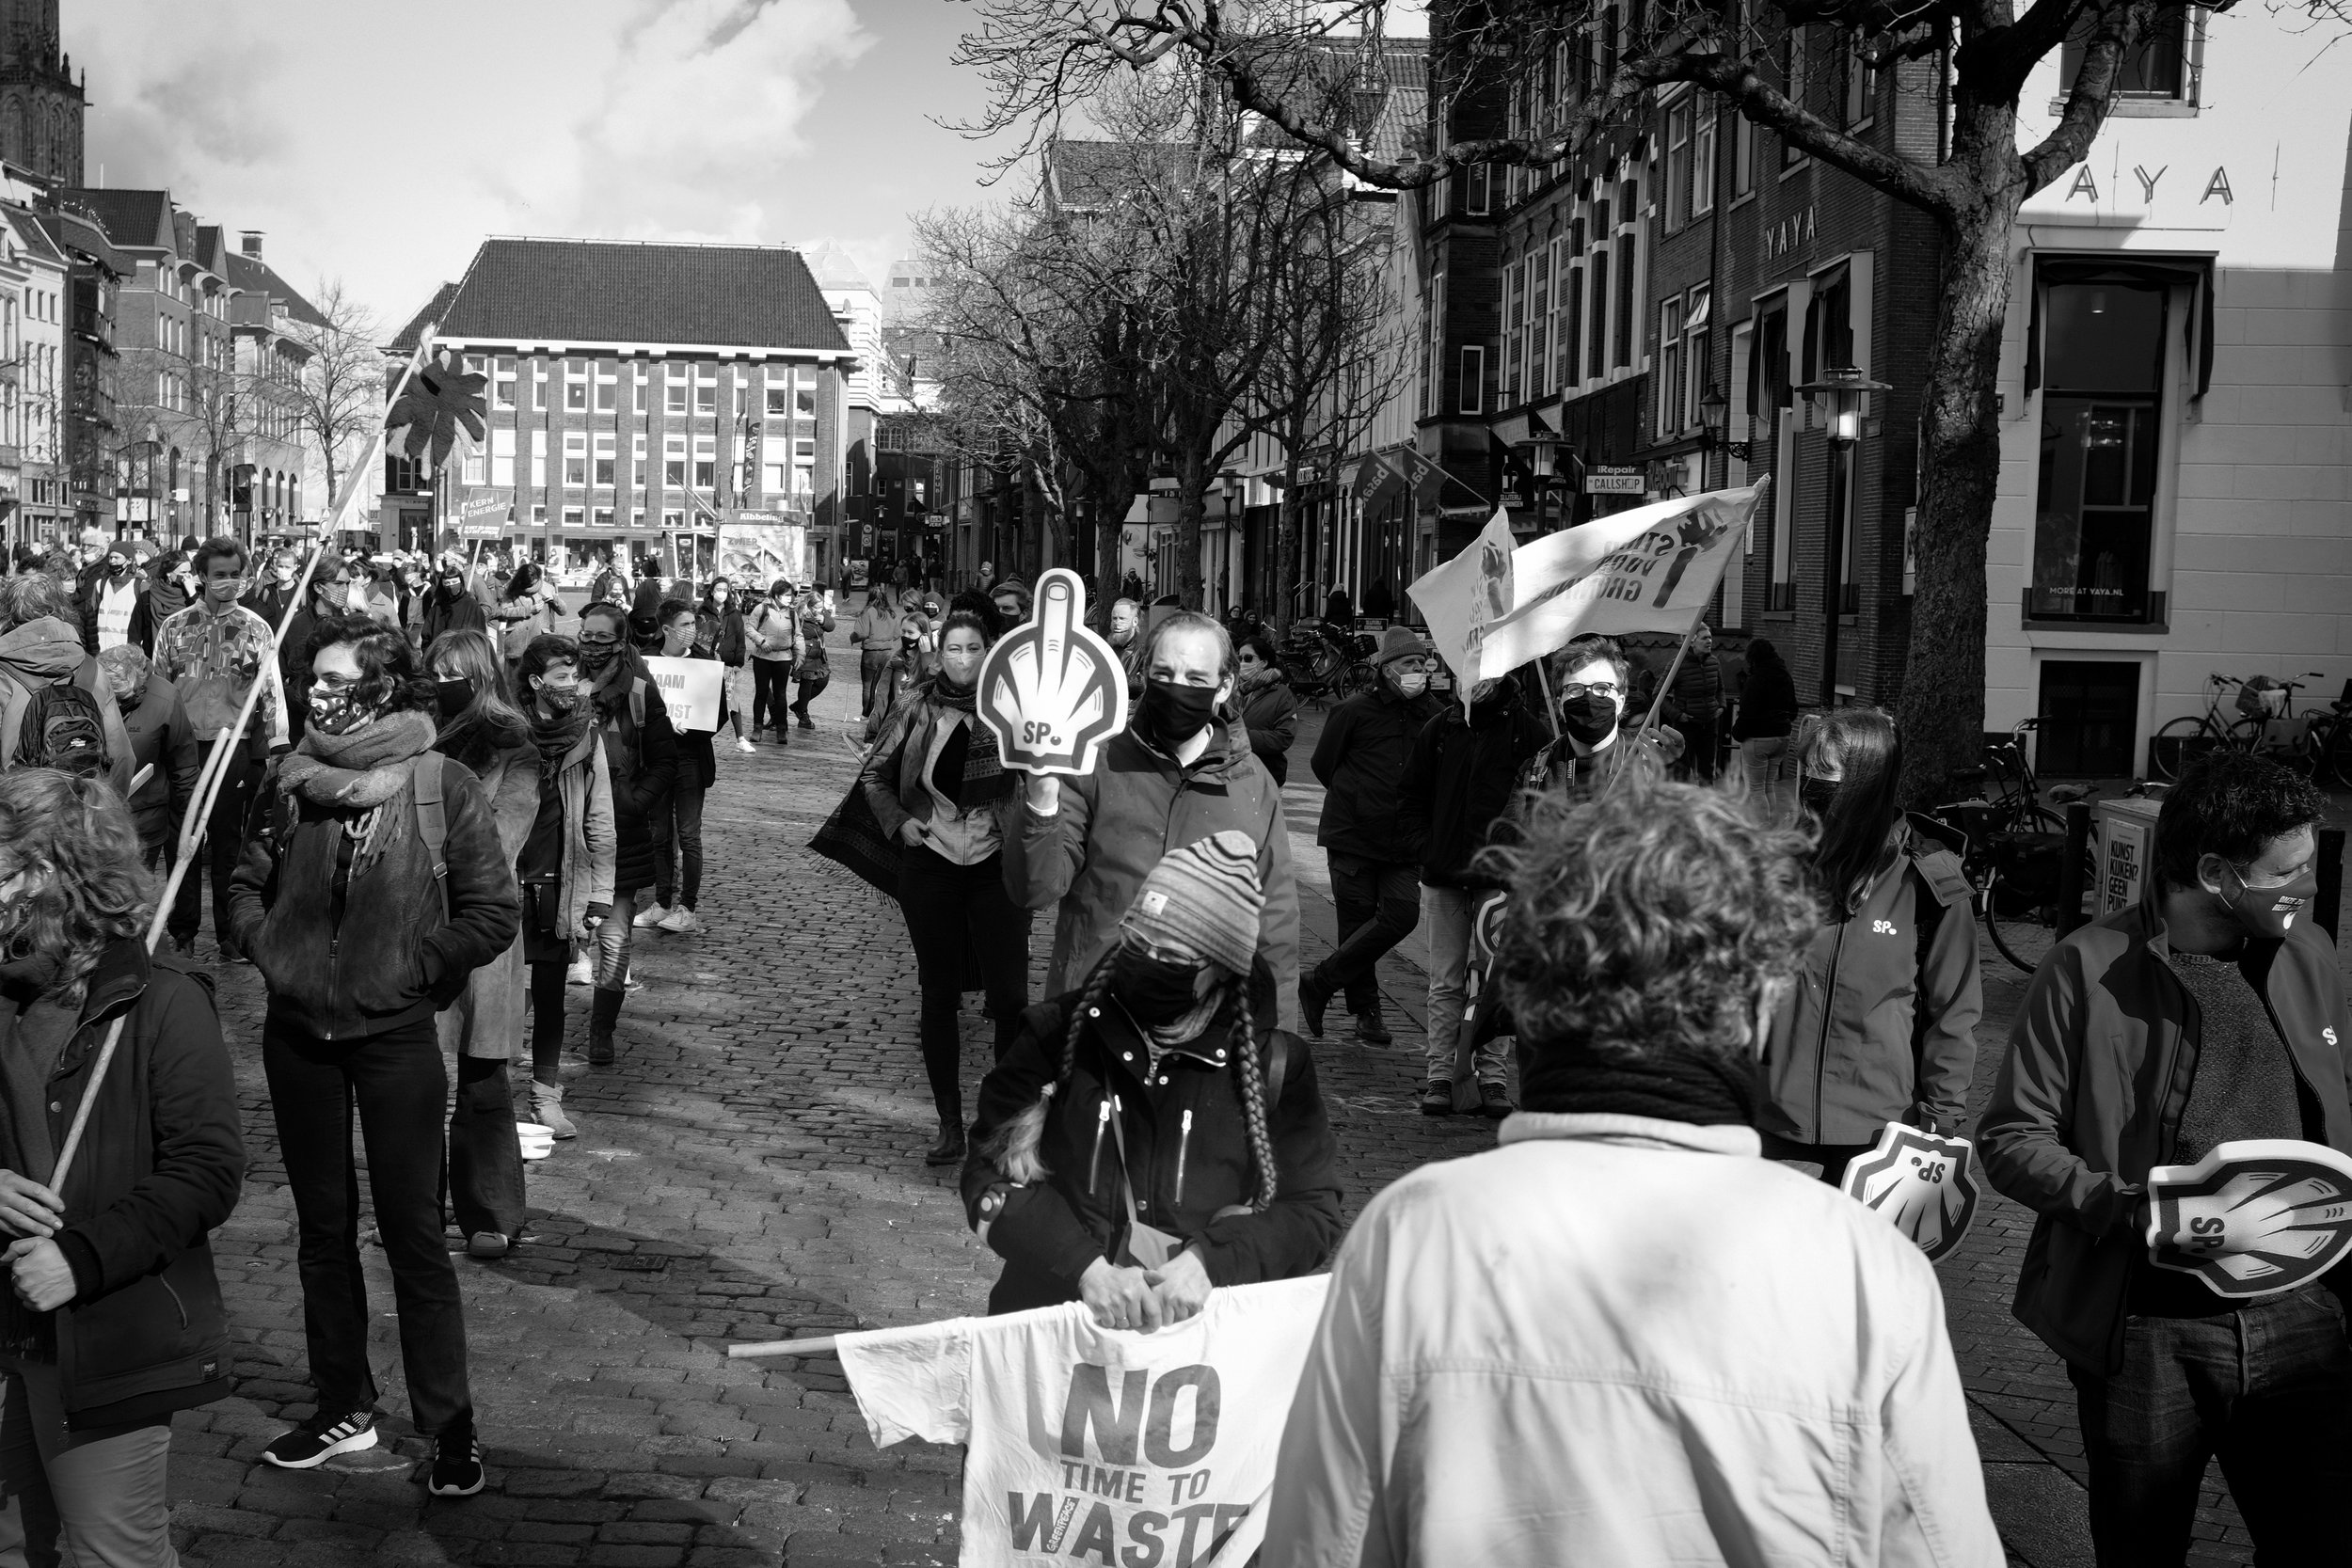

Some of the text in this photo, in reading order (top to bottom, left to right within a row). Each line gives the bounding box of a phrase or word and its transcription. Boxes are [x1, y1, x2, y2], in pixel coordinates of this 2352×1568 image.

[1767, 205, 1815, 260] YAYA
[1597, 465, 1636, 476] iRepair
[468, 501, 506, 517] ENERGIE
[470, 497, 494, 508] KERN
[739, 513, 785, 523] Kibbeling
[2049, 587, 2124, 596] MORE AT YAYA.NL
[652, 673, 685, 689] AAM
[2110, 840, 2135, 863] KUNST
[2109, 857, 2138, 882] KIJKEN?
[2108, 876, 2128, 898] GEEN
[2322, 1025, 2338, 1046] S
[1060, 1362, 1221, 1468] NO
[1059, 1460, 1211, 1505] TIME TO
[1046, 1497, 1076, 1552] GREENPEACE
